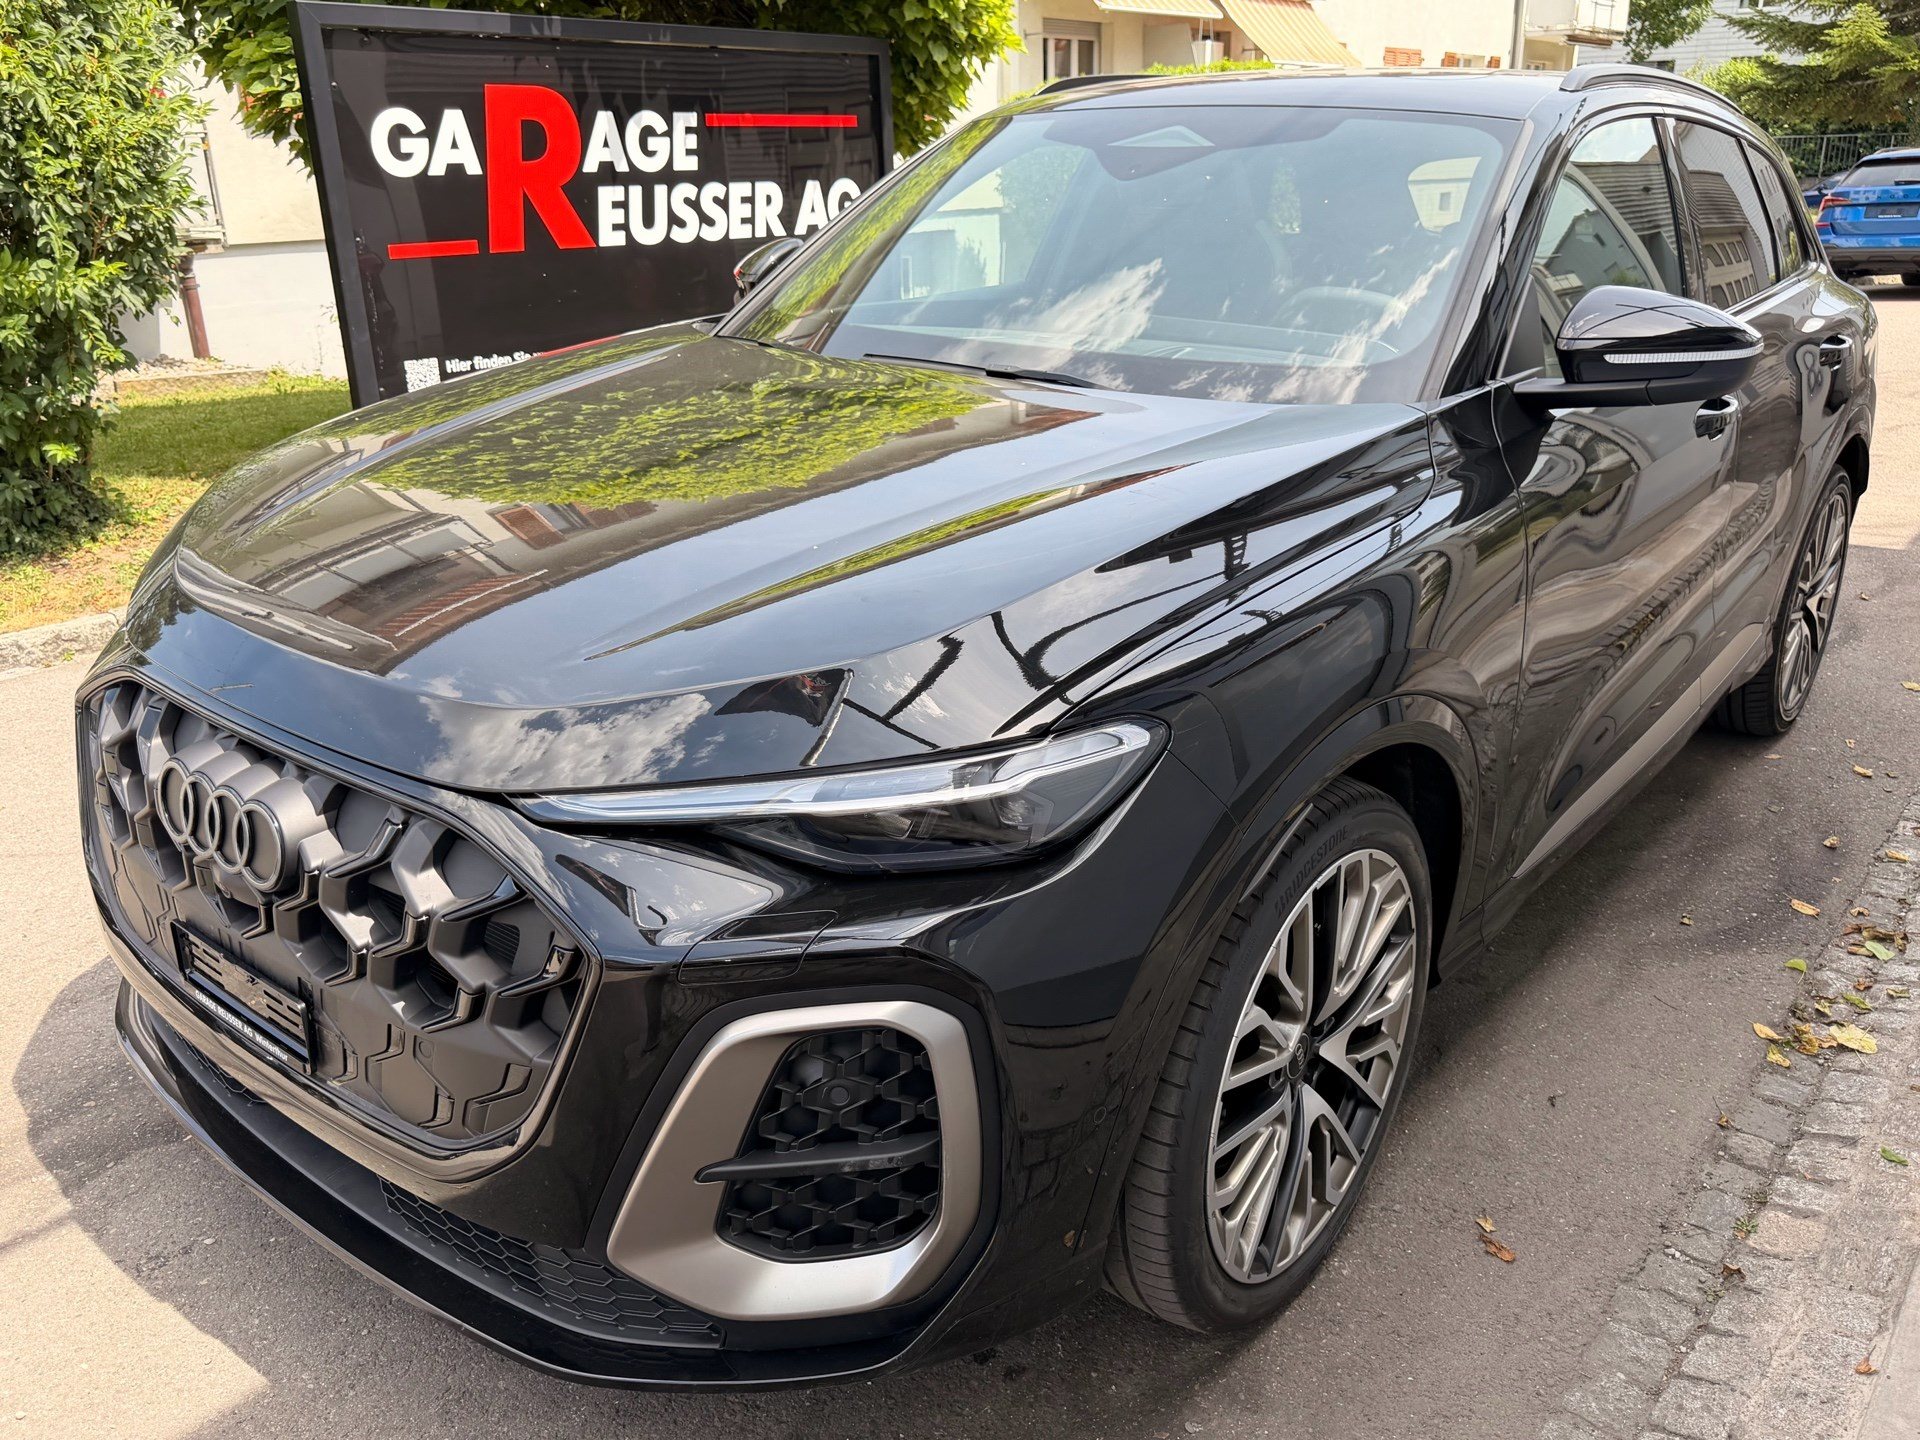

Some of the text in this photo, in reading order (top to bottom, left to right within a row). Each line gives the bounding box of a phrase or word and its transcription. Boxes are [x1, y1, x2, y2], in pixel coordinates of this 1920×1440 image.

[794, 177, 861, 236] AG
[445, 358, 472, 373] Hier
[472, 354, 512, 370] finden
[1274, 824, 1350, 917] BRIDGESTONE
[195, 990, 288, 1061] GARAGE REUSSER AG Winterthur
